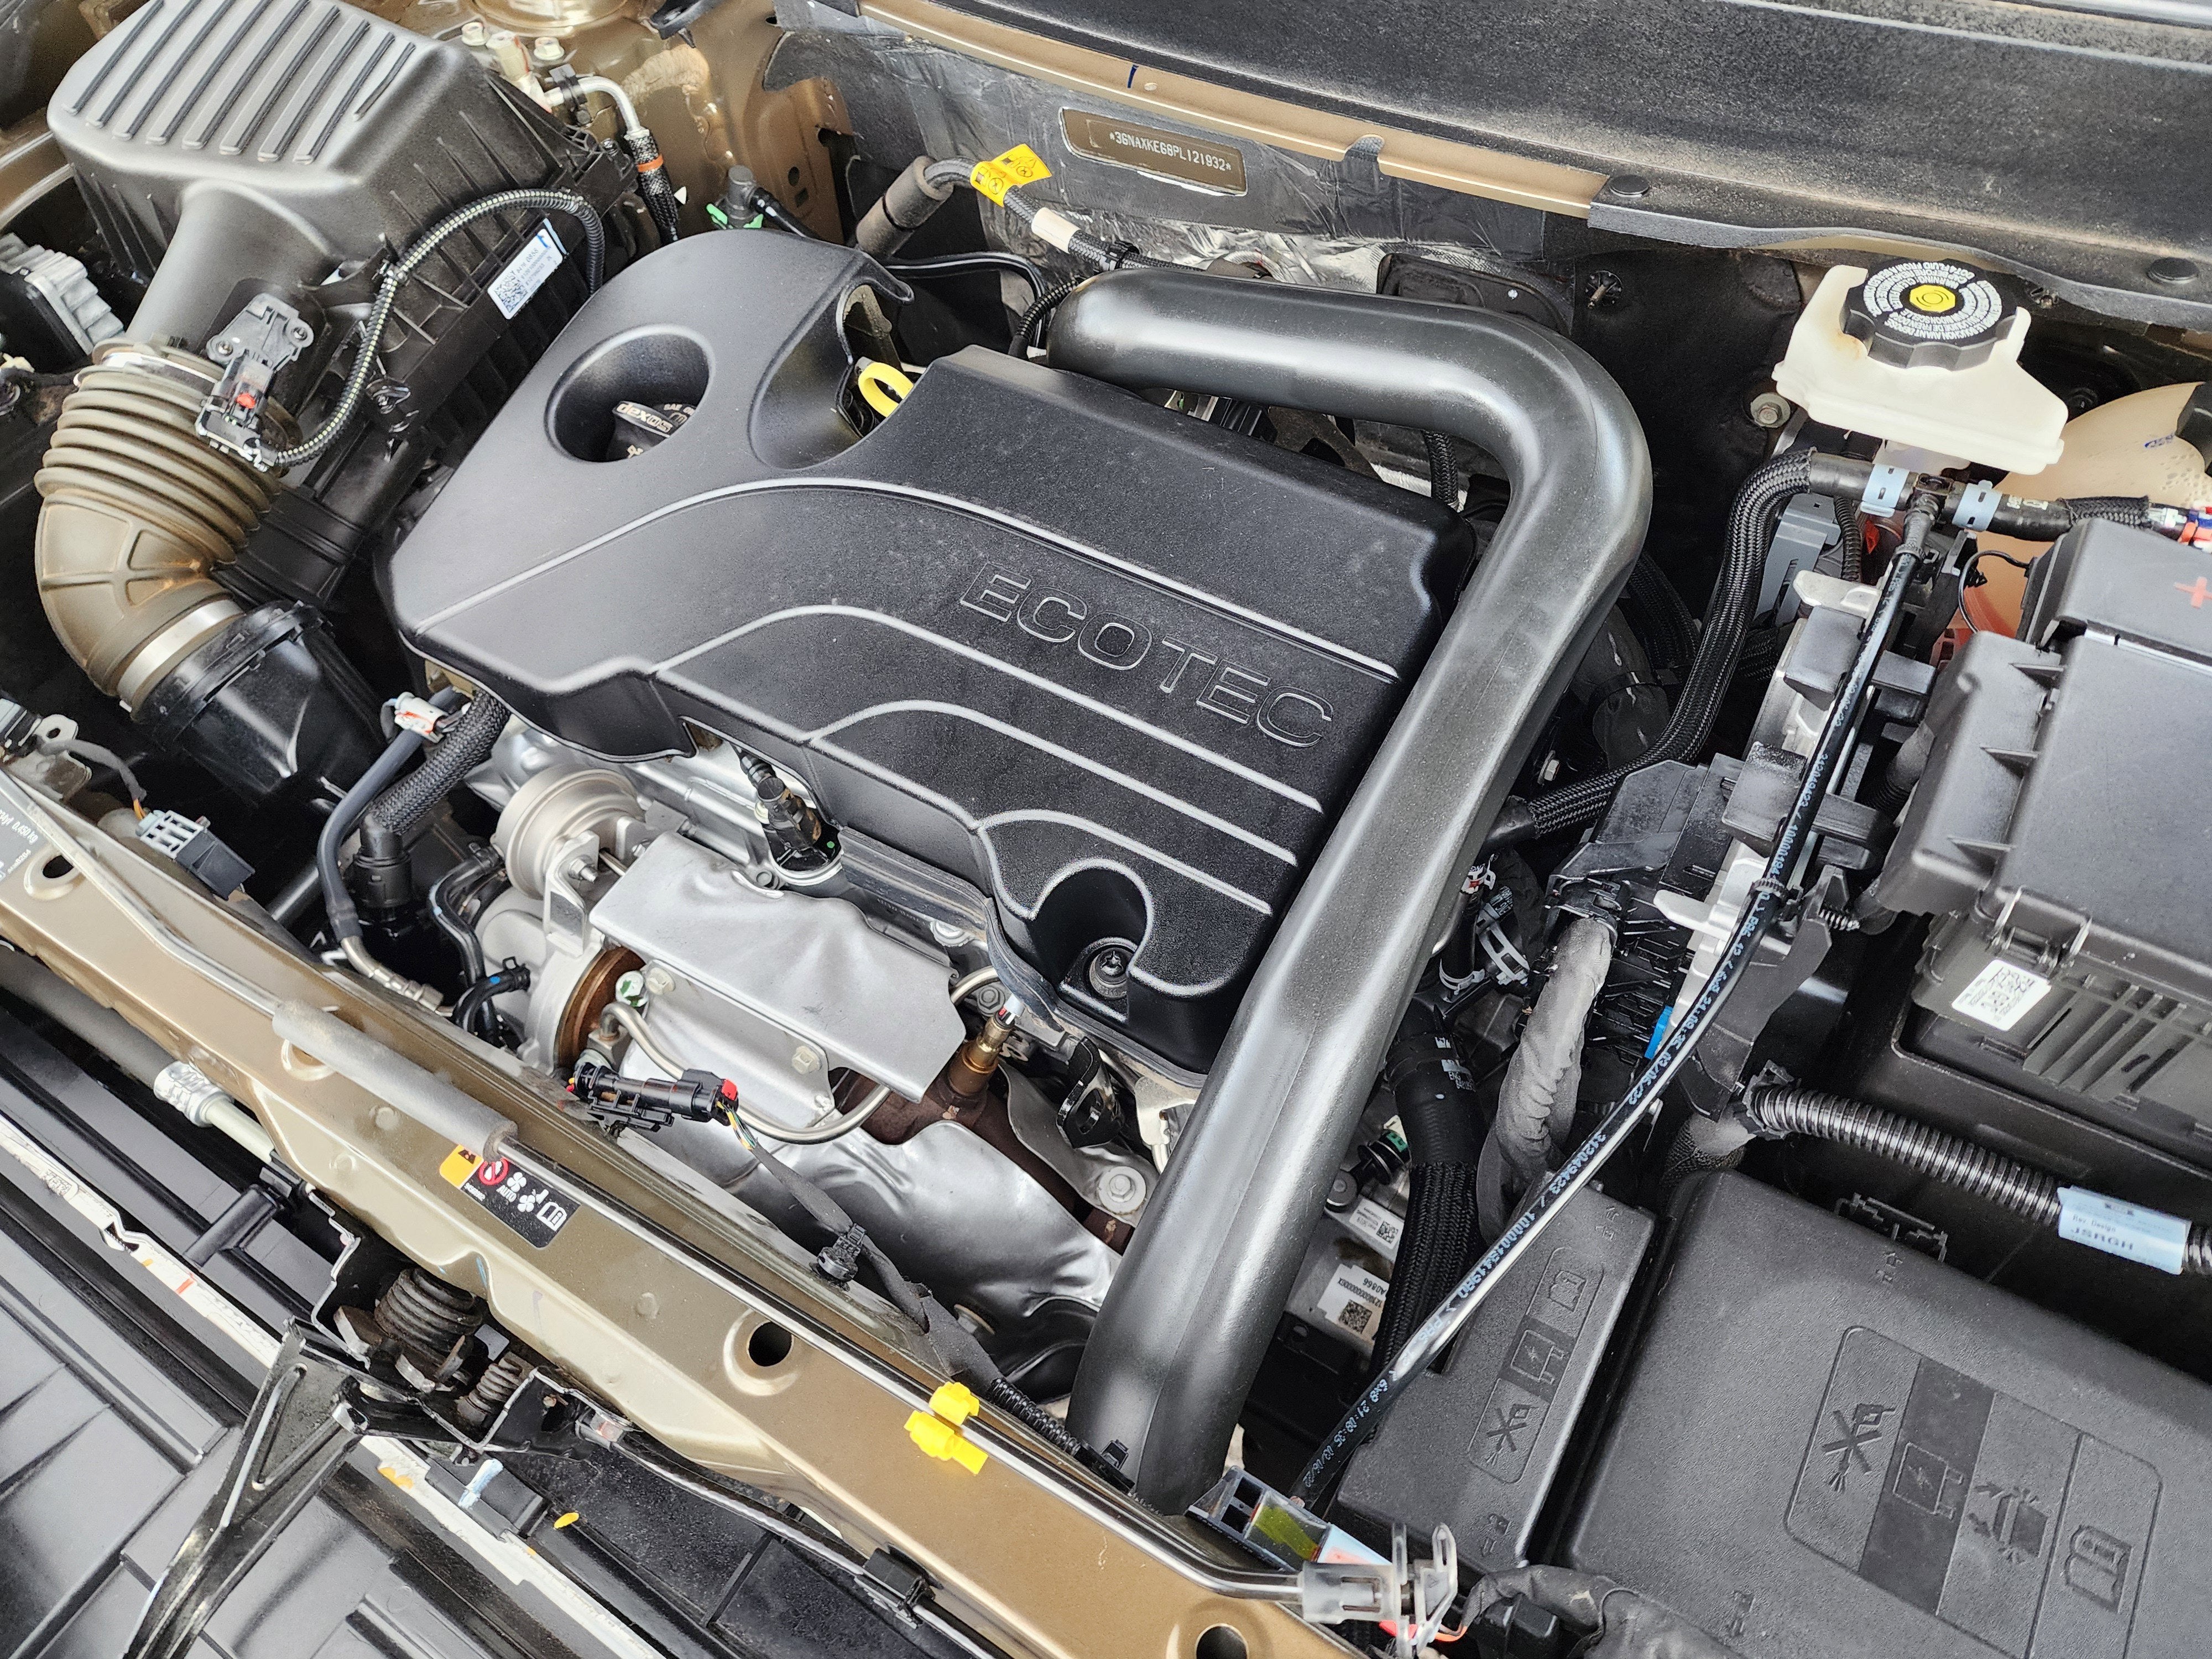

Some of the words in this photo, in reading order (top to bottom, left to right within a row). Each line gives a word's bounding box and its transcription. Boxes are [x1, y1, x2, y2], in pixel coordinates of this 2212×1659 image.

[616, 403, 673, 432] dexos
[959, 562, 1334, 748] ECOTEC
[1547, 1129, 1608, 1196] 312049423
[496, 1185, 517, 1202] AUTO
[2091, 1219, 2116, 1232] Design
[1362, 1277, 1386, 1295] A0866
